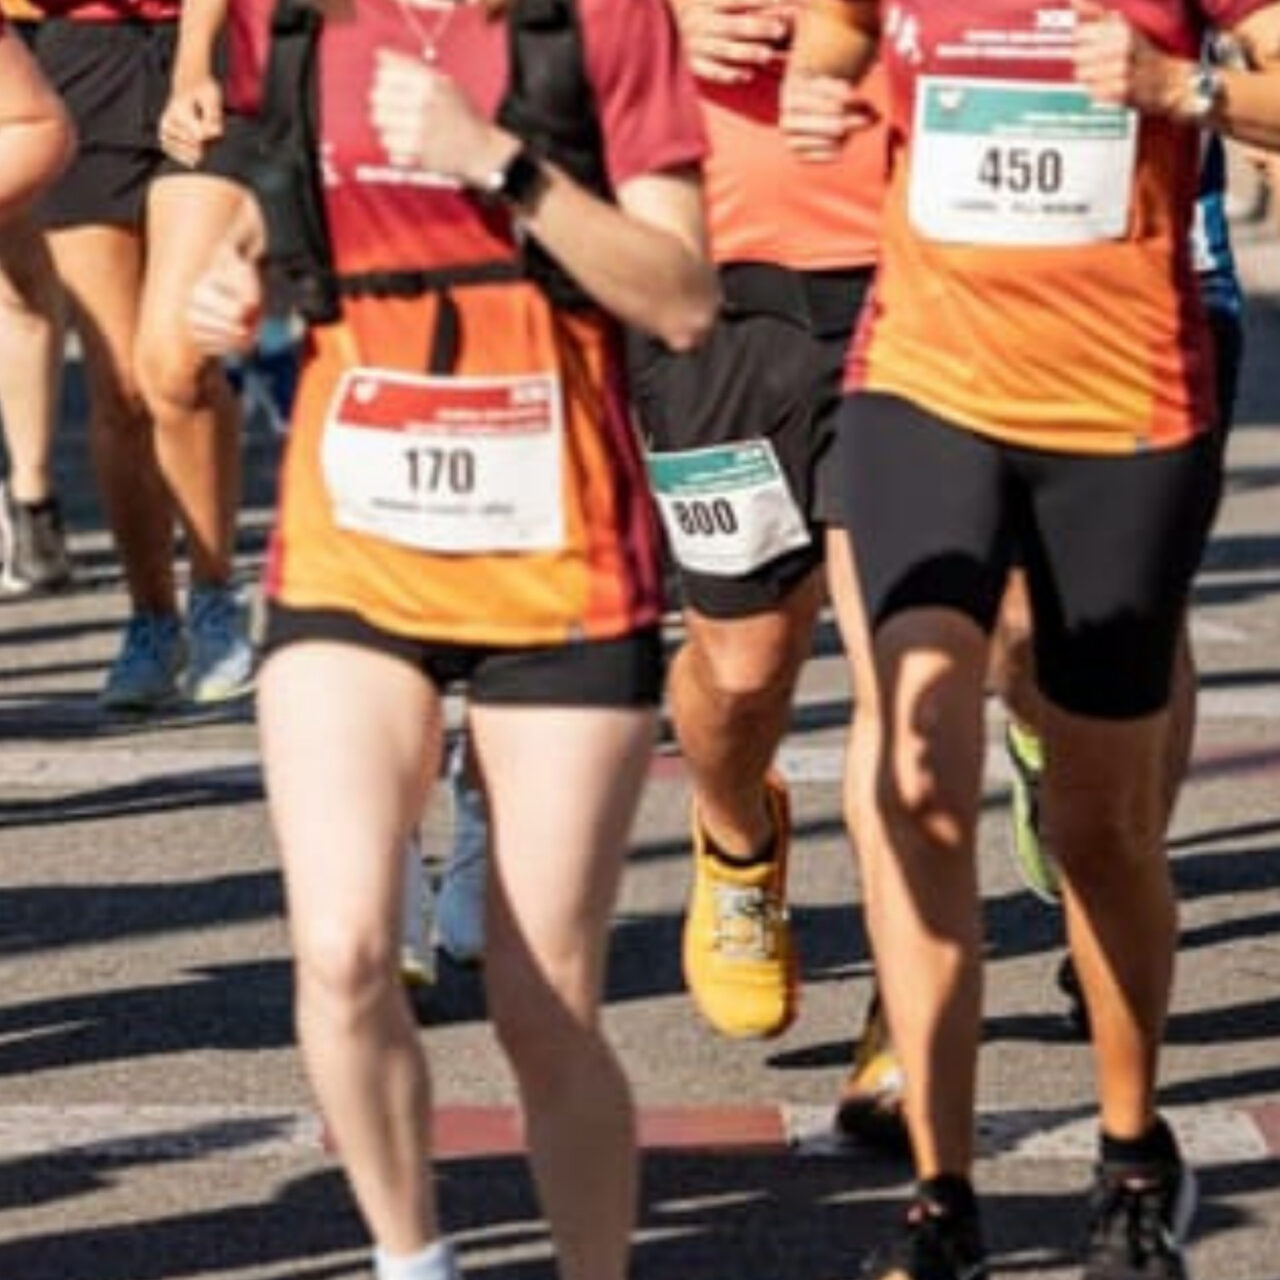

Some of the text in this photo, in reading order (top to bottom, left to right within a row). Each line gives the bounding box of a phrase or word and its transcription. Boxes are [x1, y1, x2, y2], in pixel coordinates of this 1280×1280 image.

[976, 147, 1063, 194] 450
[404, 446, 475, 493] 170
[672, 496, 740, 537] 800
